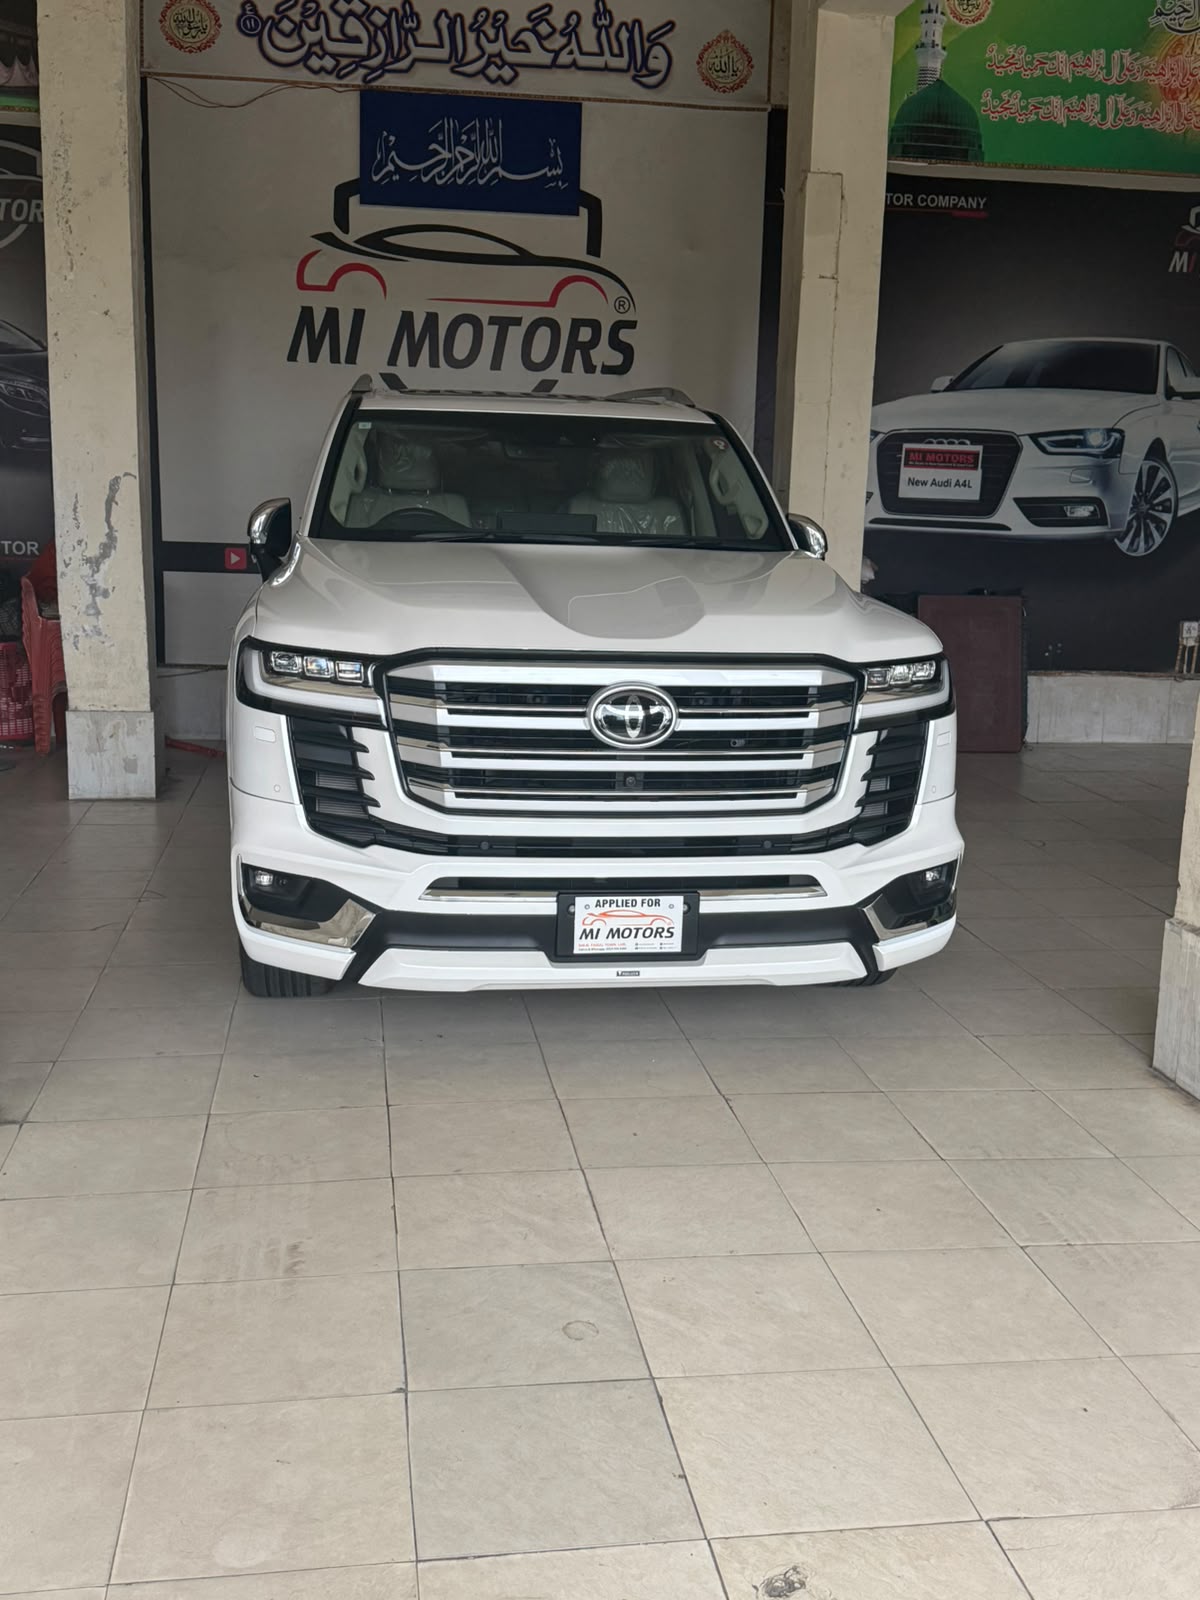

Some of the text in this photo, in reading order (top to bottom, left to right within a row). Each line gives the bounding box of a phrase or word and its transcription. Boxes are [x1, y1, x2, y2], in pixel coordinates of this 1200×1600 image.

[916, 193, 987, 210] COMPANY
[286, 305, 638, 376] MI MOTORS
[926, 453, 974, 464] MOTORS
[907, 476, 973, 489] New Audi A4L
[594, 898, 661, 909] APPLIED FOR
[578, 926, 675, 940] MI MOTORS
